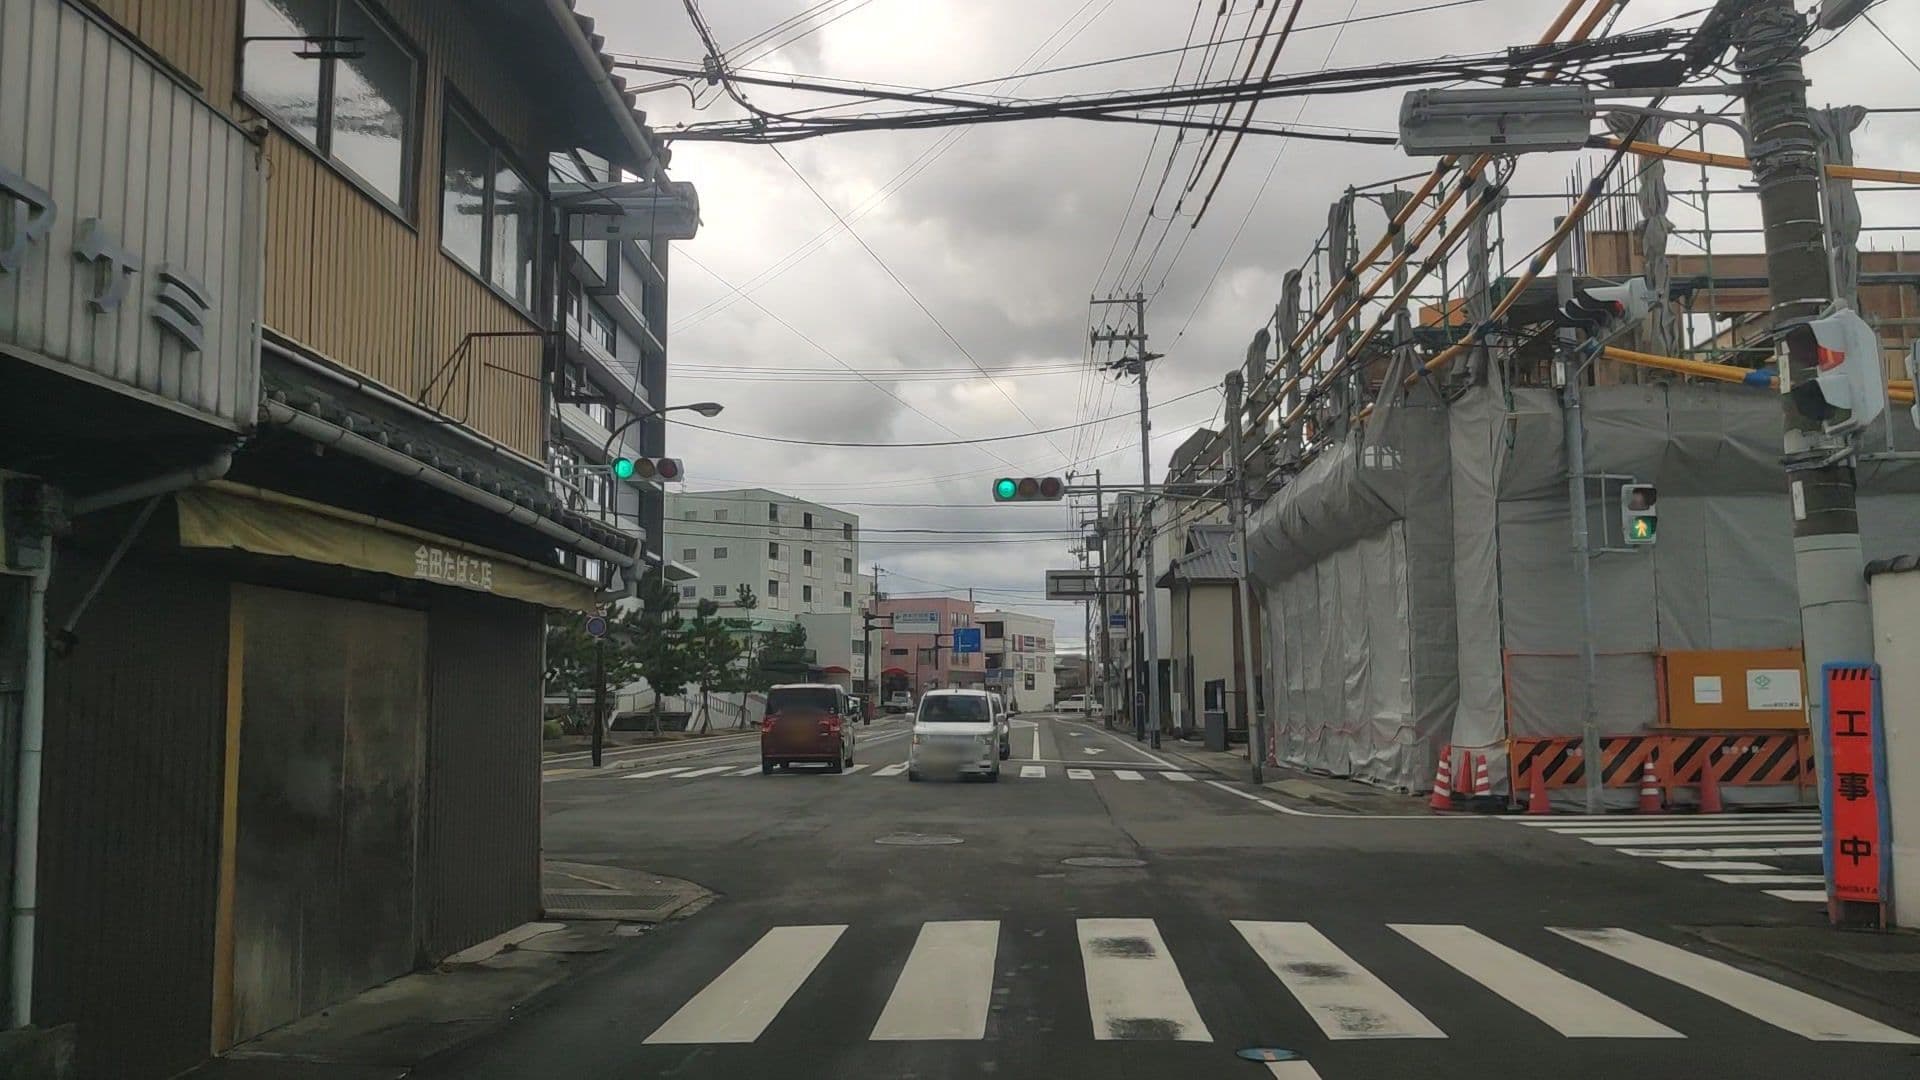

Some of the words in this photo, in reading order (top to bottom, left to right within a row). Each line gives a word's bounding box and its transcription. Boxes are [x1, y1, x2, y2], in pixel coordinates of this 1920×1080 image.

[415, 544, 492, 589] 金田たばこ店
[1837, 710, 1871, 865] 工事中
